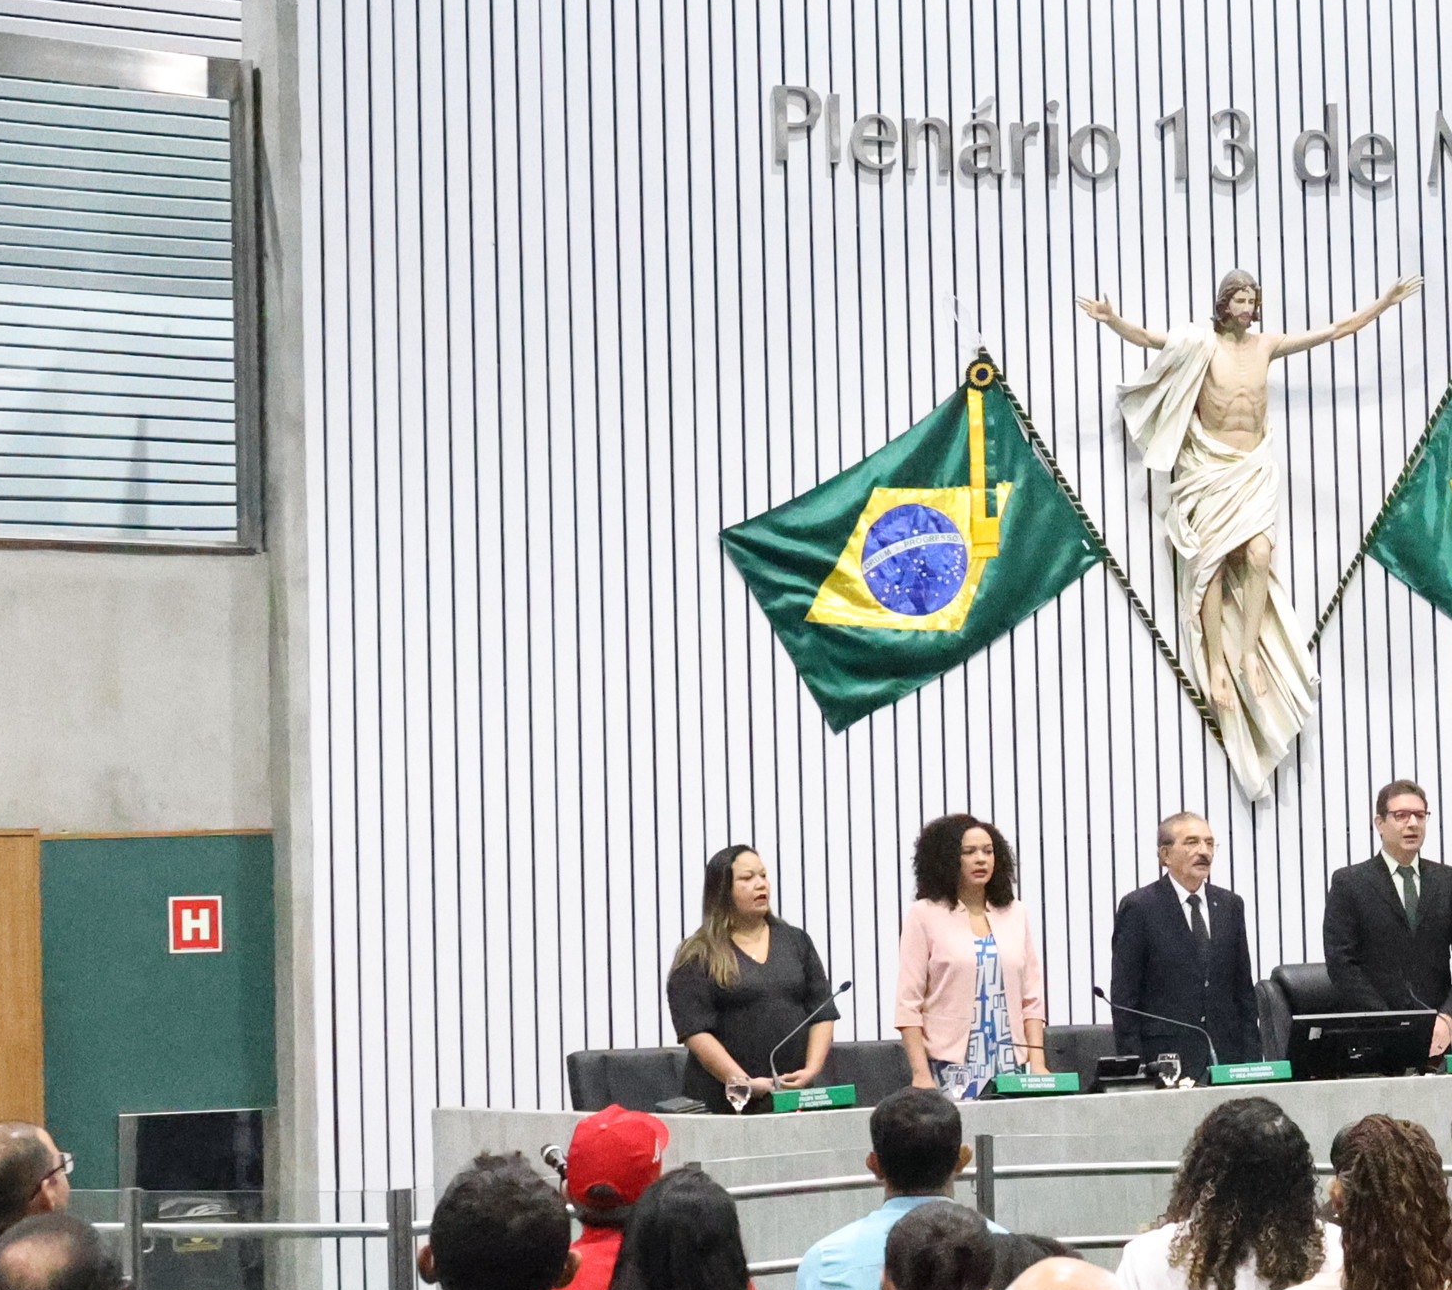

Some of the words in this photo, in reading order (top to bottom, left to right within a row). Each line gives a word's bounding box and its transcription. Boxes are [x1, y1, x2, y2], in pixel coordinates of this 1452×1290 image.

[769, 84, 1122, 182] Plenário
[1154, 105, 1257, 185] 13
[1293, 104, 1395, 188] de
[903, 534, 959, 548] PROGRESSO
[181, 908, 210, 941] H
